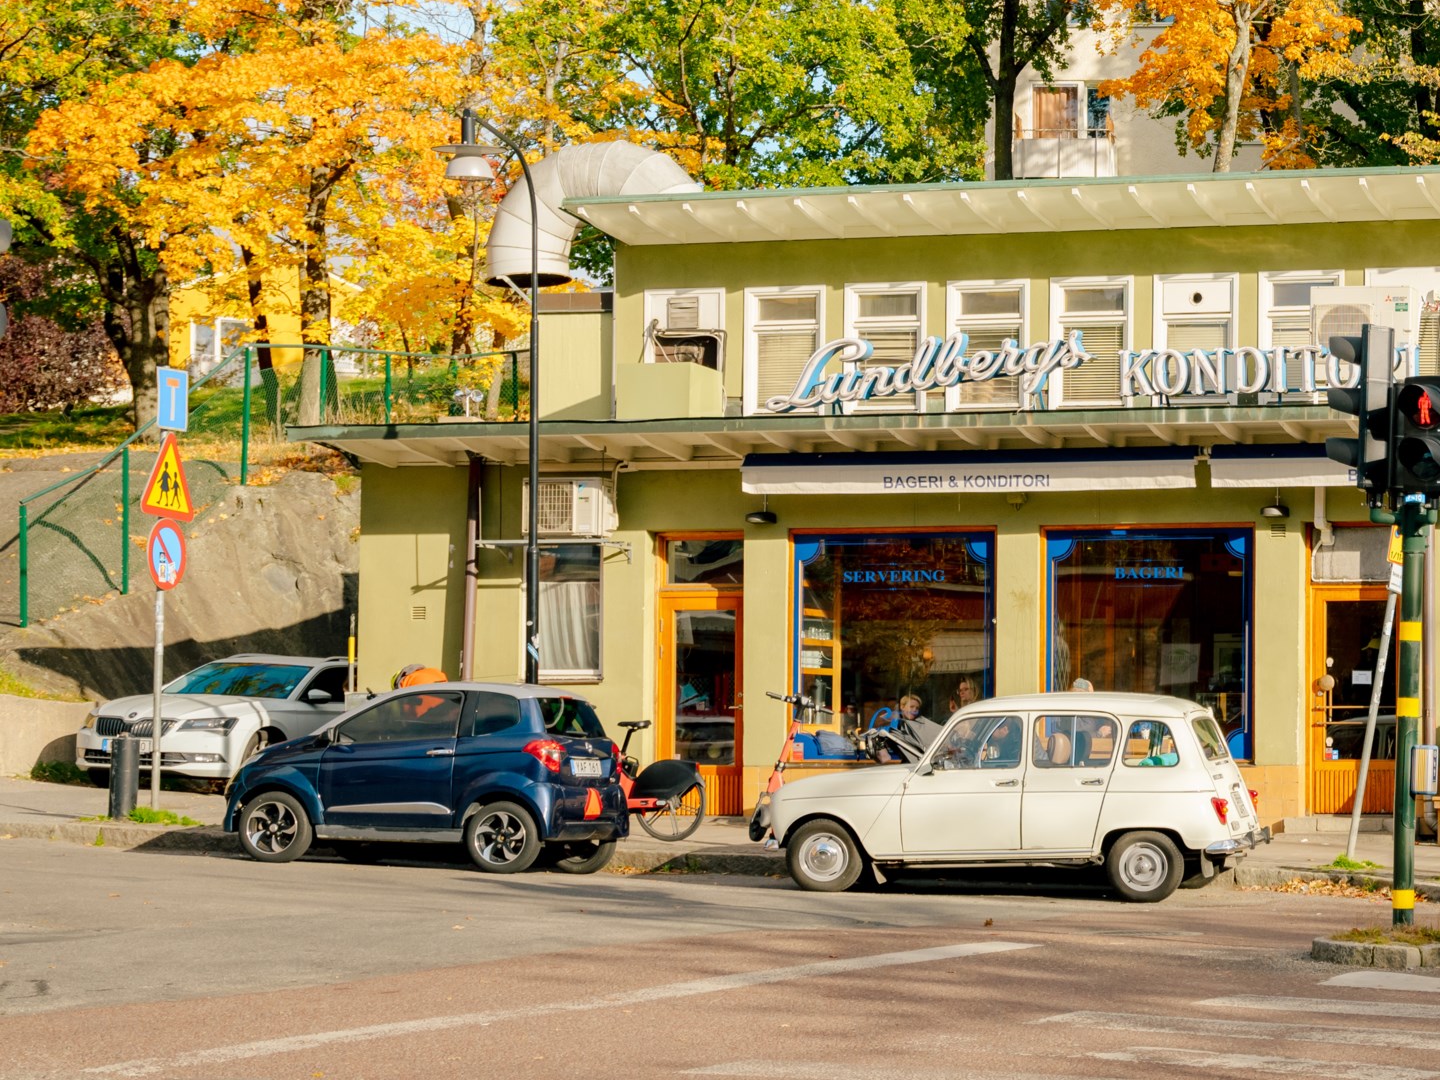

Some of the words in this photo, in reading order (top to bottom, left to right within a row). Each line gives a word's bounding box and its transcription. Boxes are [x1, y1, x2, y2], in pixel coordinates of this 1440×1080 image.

[766, 330, 1097, 412] Lundbergs
[1118, 345, 1421, 398] KONDITOI
[883, 475, 943, 489] BAGERI
[948, 475, 958, 488] &
[963, 474, 1050, 488] KONDITORI
[843, 570, 946, 583] SERVERING
[1115, 566, 1185, 579] BAGERI
